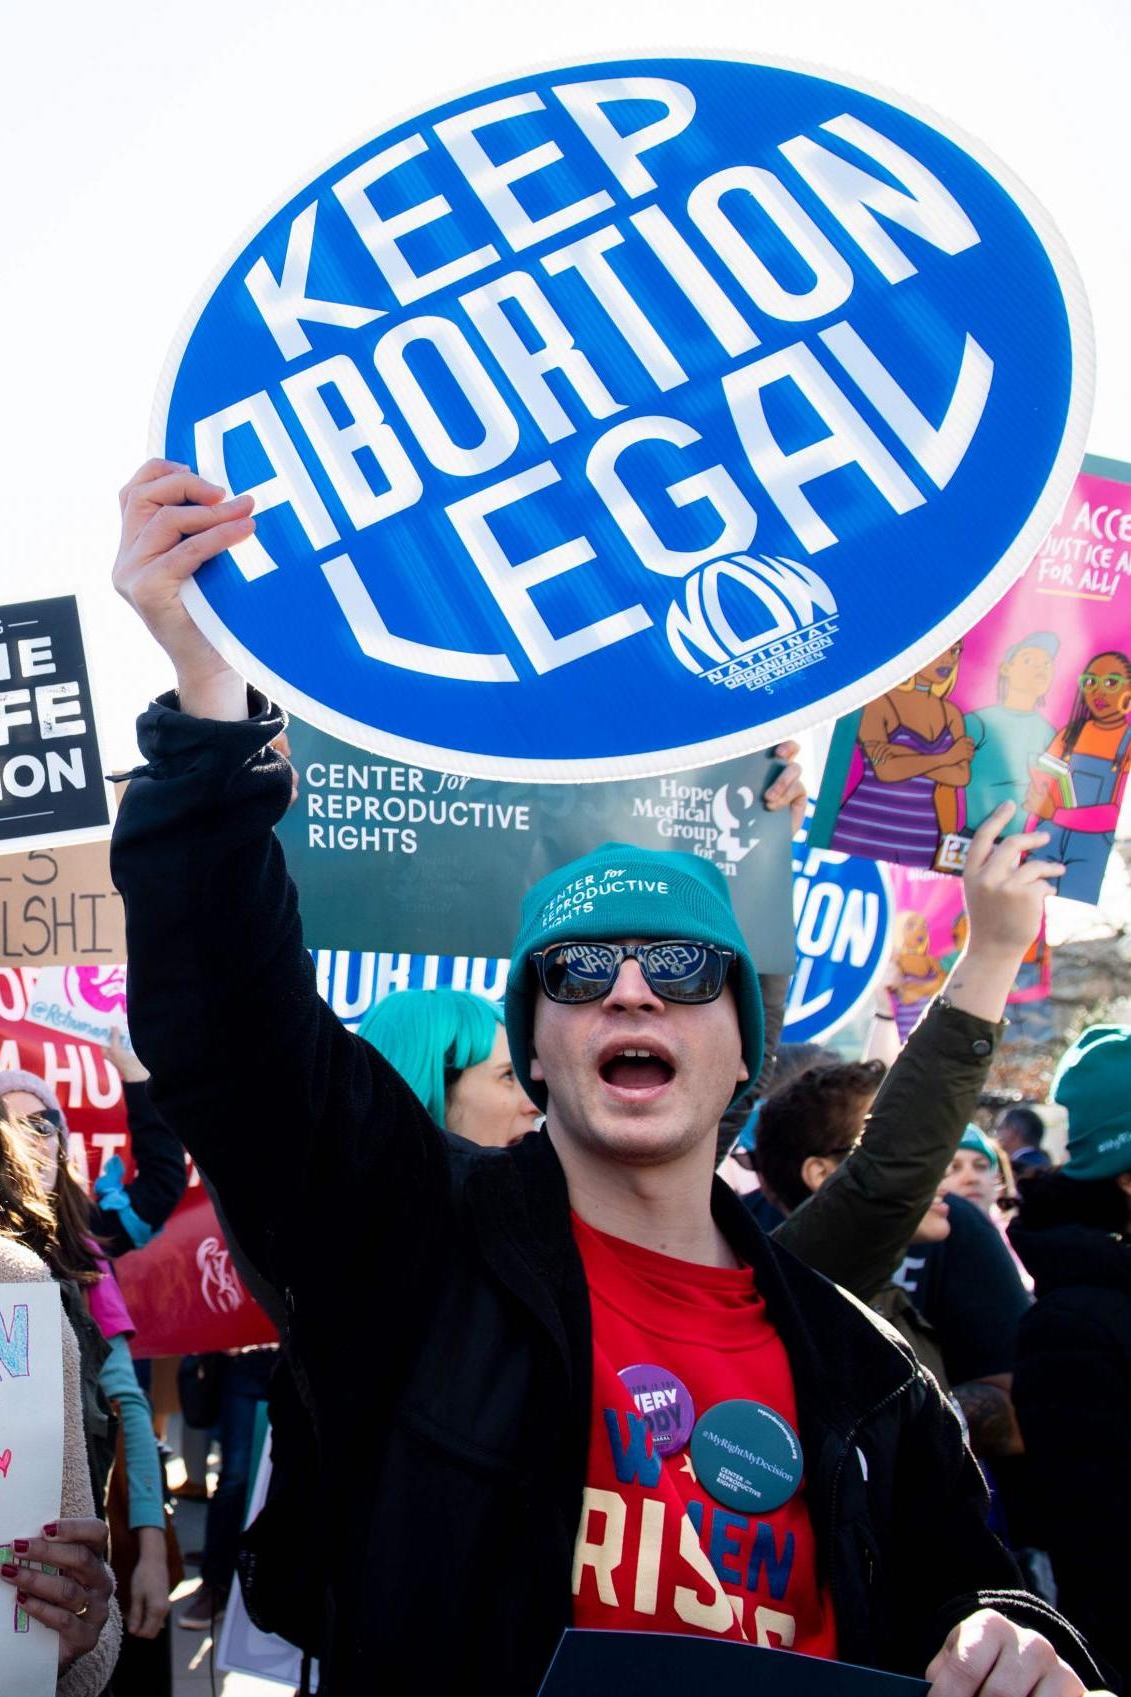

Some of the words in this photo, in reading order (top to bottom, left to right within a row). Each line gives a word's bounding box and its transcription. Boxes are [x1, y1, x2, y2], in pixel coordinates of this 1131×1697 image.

[243, 76, 697, 361] KEEP
[193, 112, 982, 583] ABORTION
[320, 320, 995, 683] LEGAL
[666, 555, 838, 676] NOW
[706, 622, 838, 683] NATIONAL
[724, 636, 833, 688] ORGANIZATION
[745, 672, 772, 690] FOR
[772, 650, 825, 677] WOMEN
[306, 763, 426, 793] CENTER
[432, 772, 471, 795] for
[660, 779, 713, 808] Hope
[308, 794, 530, 830] REPRODUCTIVE
[632, 797, 711, 823] Medical
[309, 824, 418, 854] RIGHTS
[657, 818, 718, 849] Group
[600, 868, 627, 883] for
[718, 1471, 762, 1498] REPRODUCTIVE
[720, 1466, 744, 1482] CENTER
